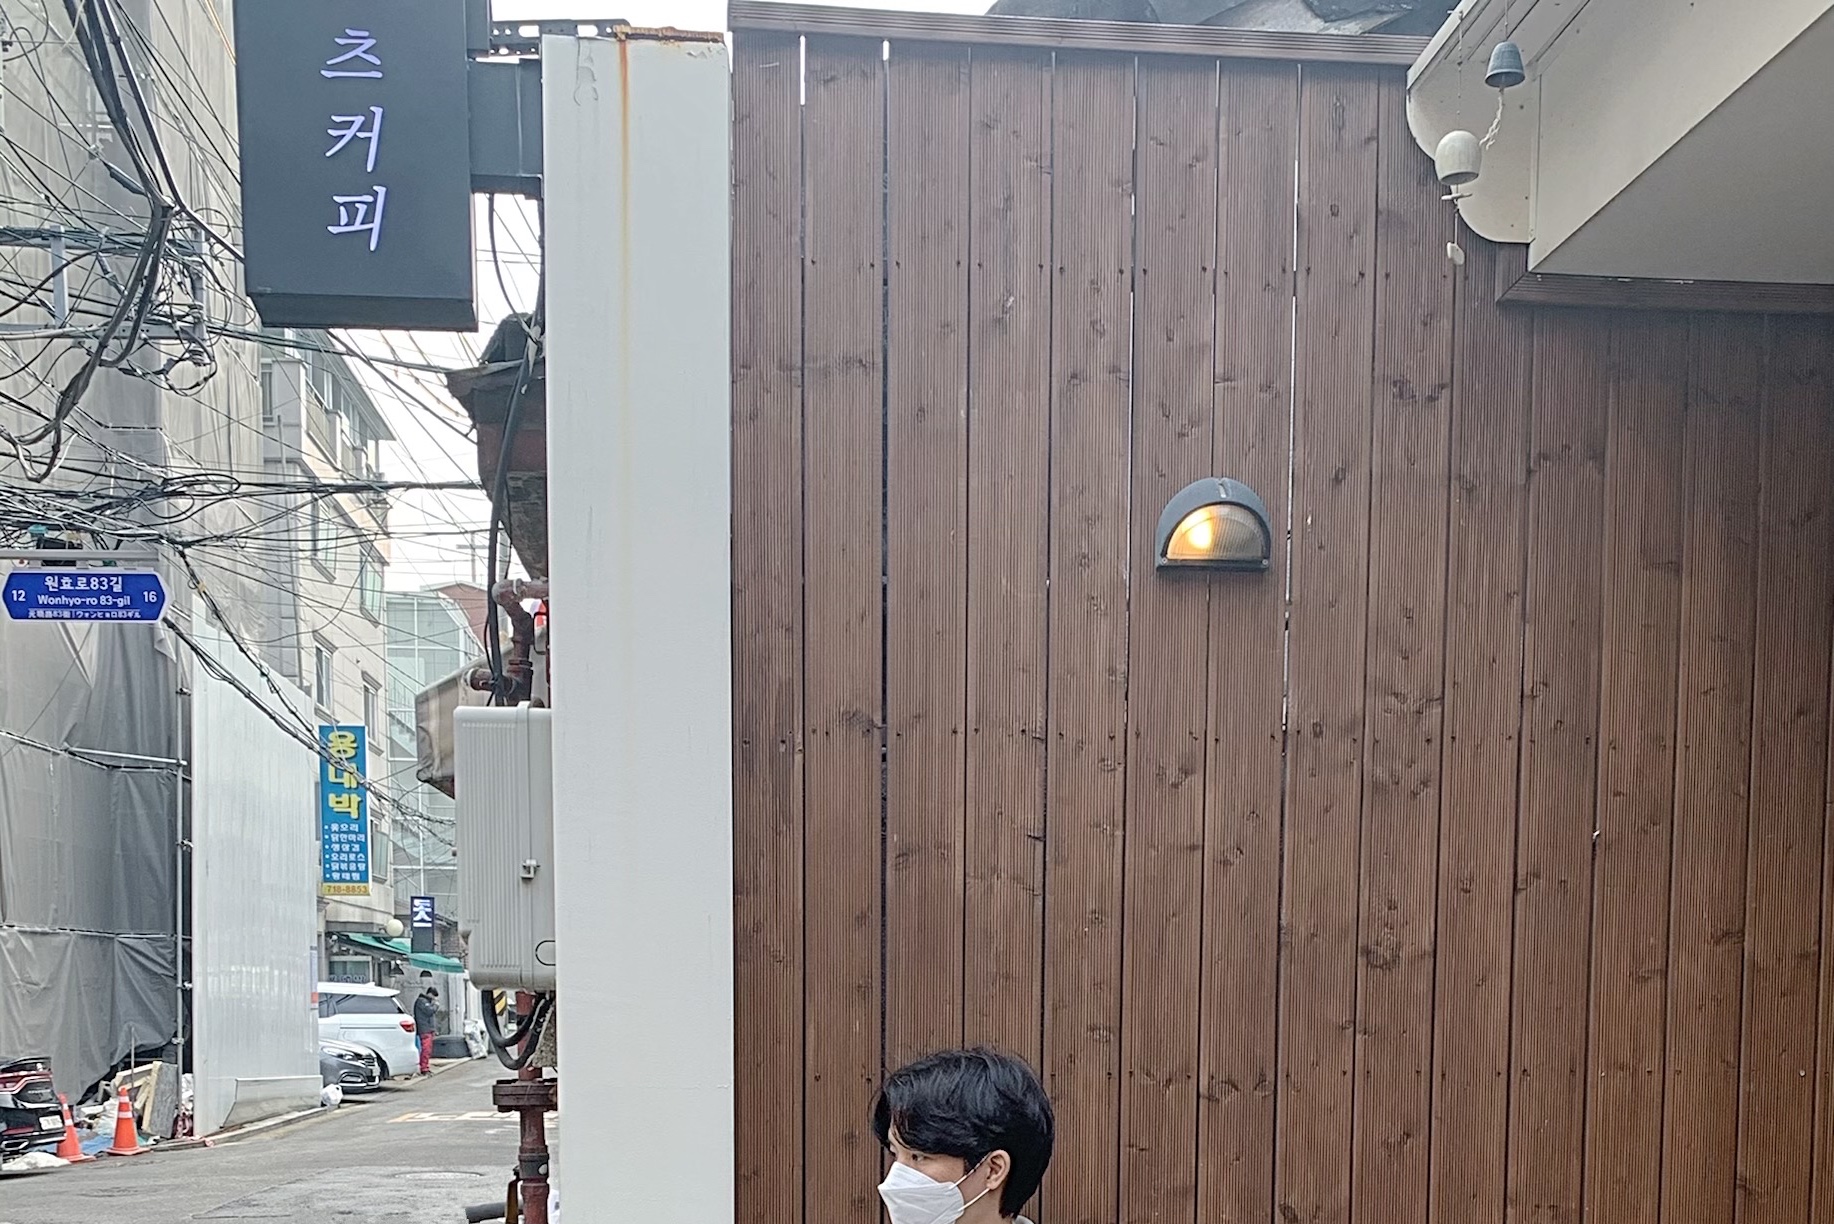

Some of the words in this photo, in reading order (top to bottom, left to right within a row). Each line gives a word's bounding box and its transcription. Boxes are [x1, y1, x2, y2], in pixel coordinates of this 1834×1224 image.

[44, 575, 123, 593] 원효로83길
[11, 590, 26, 602] 12
[37, 594, 98, 607] Wonhyo-ro
[99, 594, 131, 607] 83-gil
[143, 591, 158, 603] 16
[326, 885, 368, 893] 718-8853
